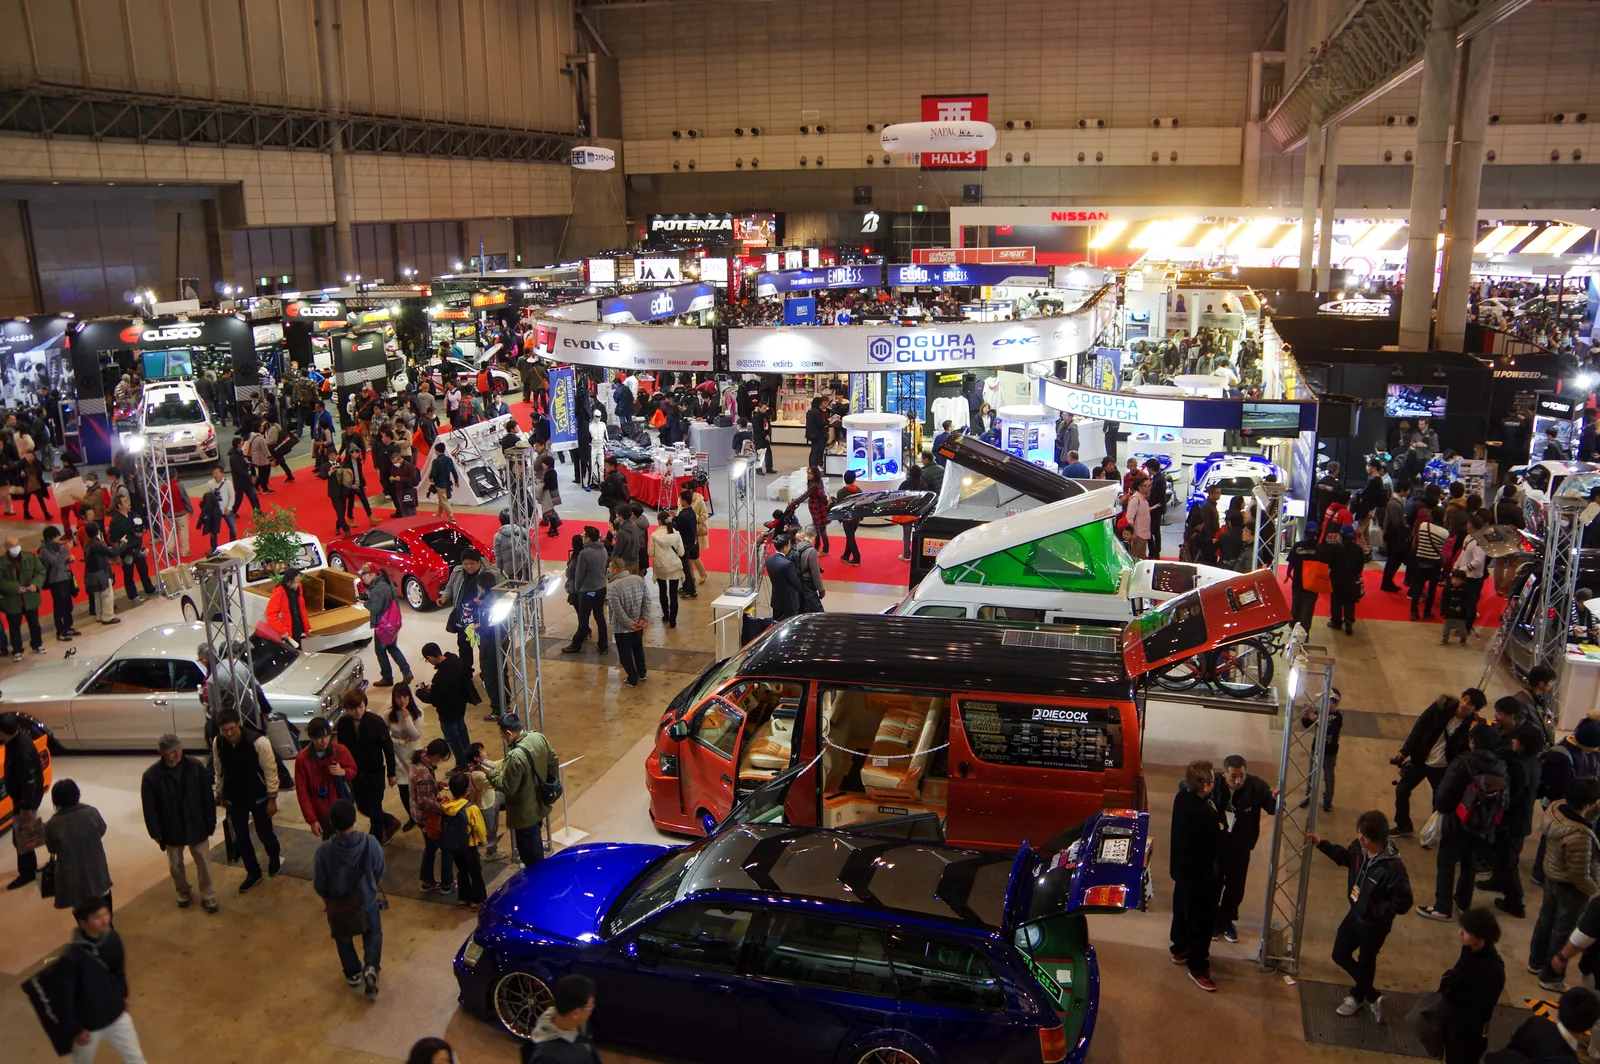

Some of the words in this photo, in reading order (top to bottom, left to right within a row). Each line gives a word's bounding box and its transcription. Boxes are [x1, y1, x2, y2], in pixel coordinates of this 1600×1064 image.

[1051, 211, 1109, 221] NISSAN
[652, 219, 732, 231] POTENZA
[999, 250, 1027, 258] SPIRIT
[828, 268, 862, 284] ENDLESS
[934, 273, 940, 281] by
[943, 271, 967, 280] ENDLESS
[650, 292, 674, 315] edirb
[142, 327, 202, 341] CUSCO
[563, 338, 620, 351] EVOLVE
[896, 334, 976, 348] OGURA
[896, 348, 976, 363] CLUTCH
[773, 360, 793, 368] edirb
[1500, 370, 1541, 379] POWERED
[1081, 393, 1138, 409] OGURA
[1081, 404, 1138, 421] CLUTCH
[1042, 709, 1089, 720] DIECOCK
